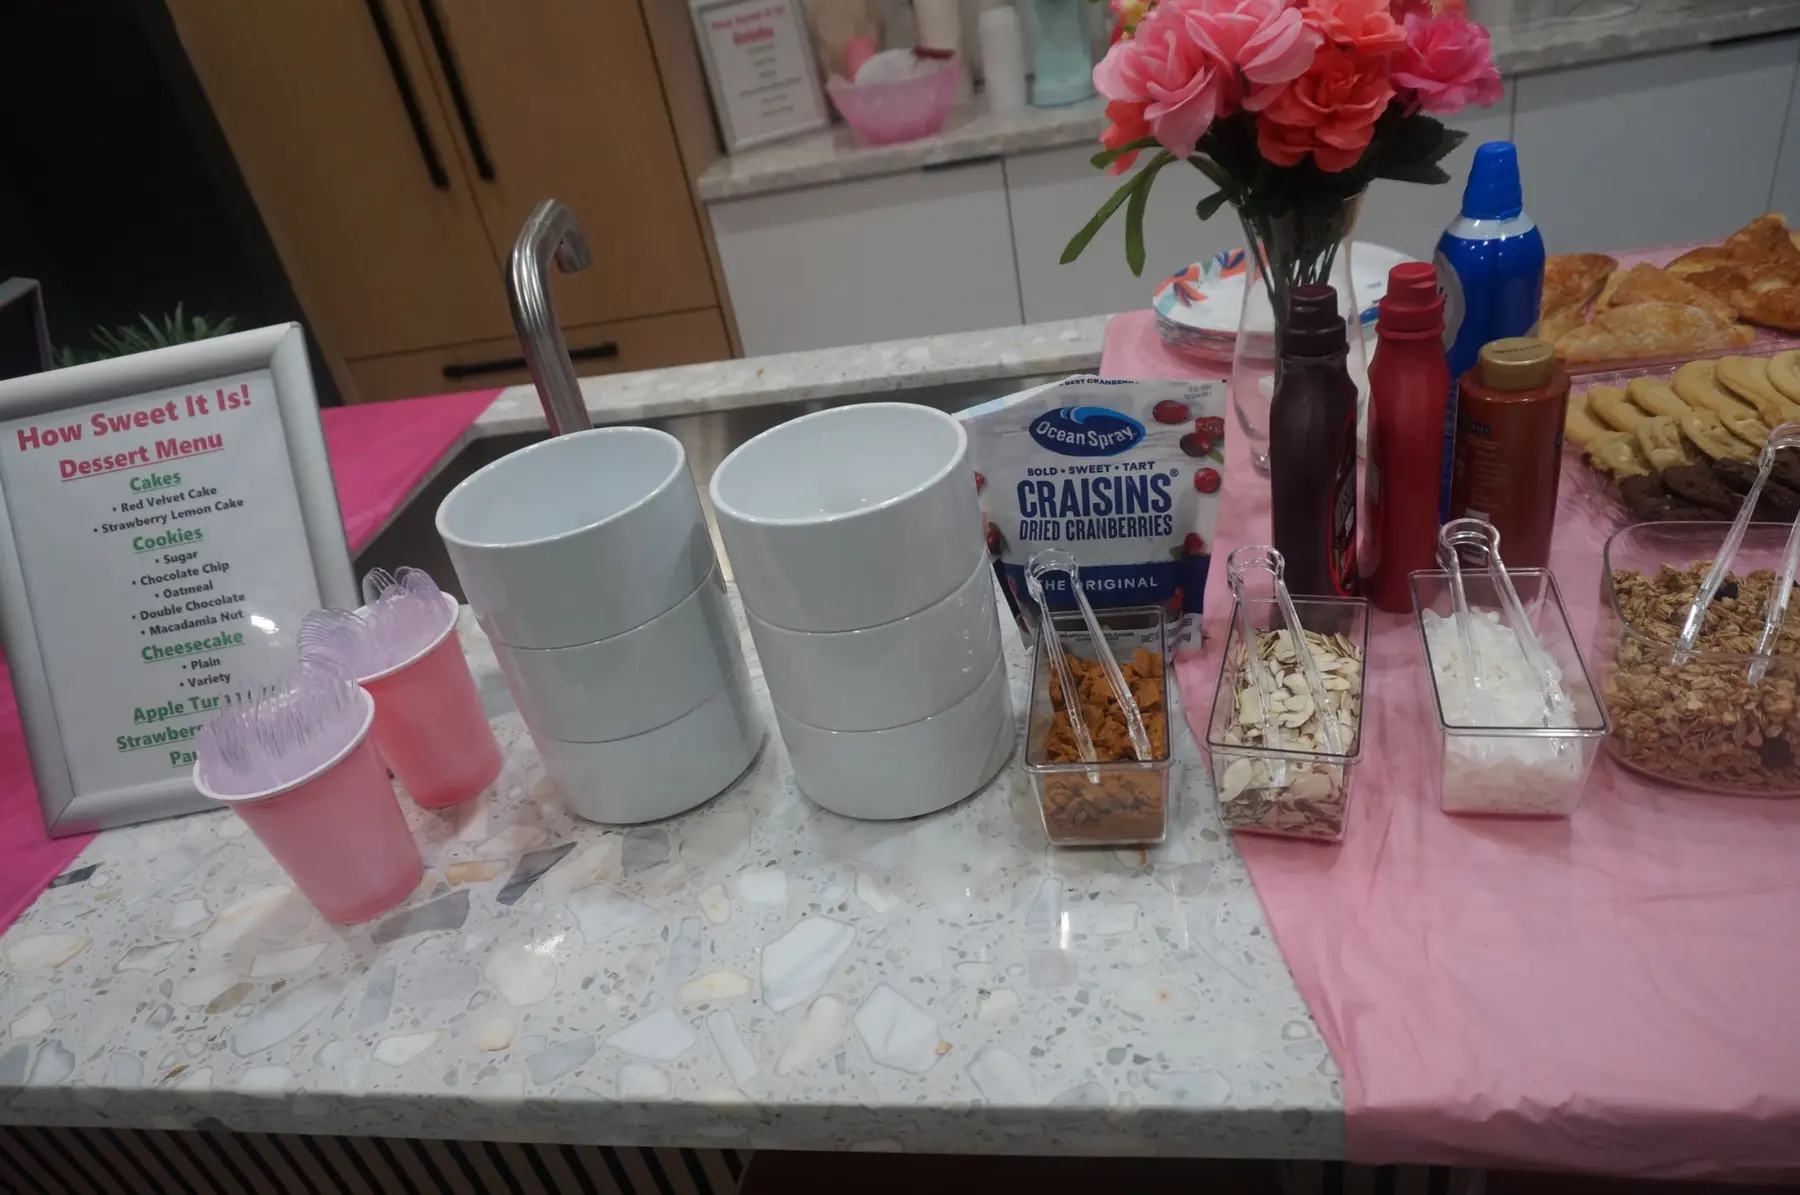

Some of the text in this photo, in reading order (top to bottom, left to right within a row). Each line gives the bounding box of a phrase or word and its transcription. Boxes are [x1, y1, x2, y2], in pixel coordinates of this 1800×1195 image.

[17, 384, 252, 451] How Sweet It Is!
[1036, 421, 1134, 449] Ocean Spray
[59, 432, 224, 481] Dessert Menu
[1027, 461, 1156, 477] BOLD SWEET TART
[129, 470, 183, 493] Cakes
[120, 485, 217, 513] Red Velvet Cake
[102, 498, 244, 534] Strawberry Lemon Cake
[1019, 513, 1173, 541] DRIED CRANBERRIES
[132, 526, 204, 553] Cookies
[163, 550, 199, 566] Sugar
[140, 560, 230, 586] Chocolate Chip
[1039, 577, 1158, 591] HE RIGINAL
[163, 580, 214, 599] Oatmeal
[140, 592, 246, 621] Double Chocolate
[149, 609, 244, 636] Macadamia Nut
[141, 630, 245, 663] Cheesecake
[190, 656, 221, 670] Plain
[187, 672, 231, 689] Variety
[133, 701, 186, 724] Apple
[116, 723, 204, 752] Strawber
